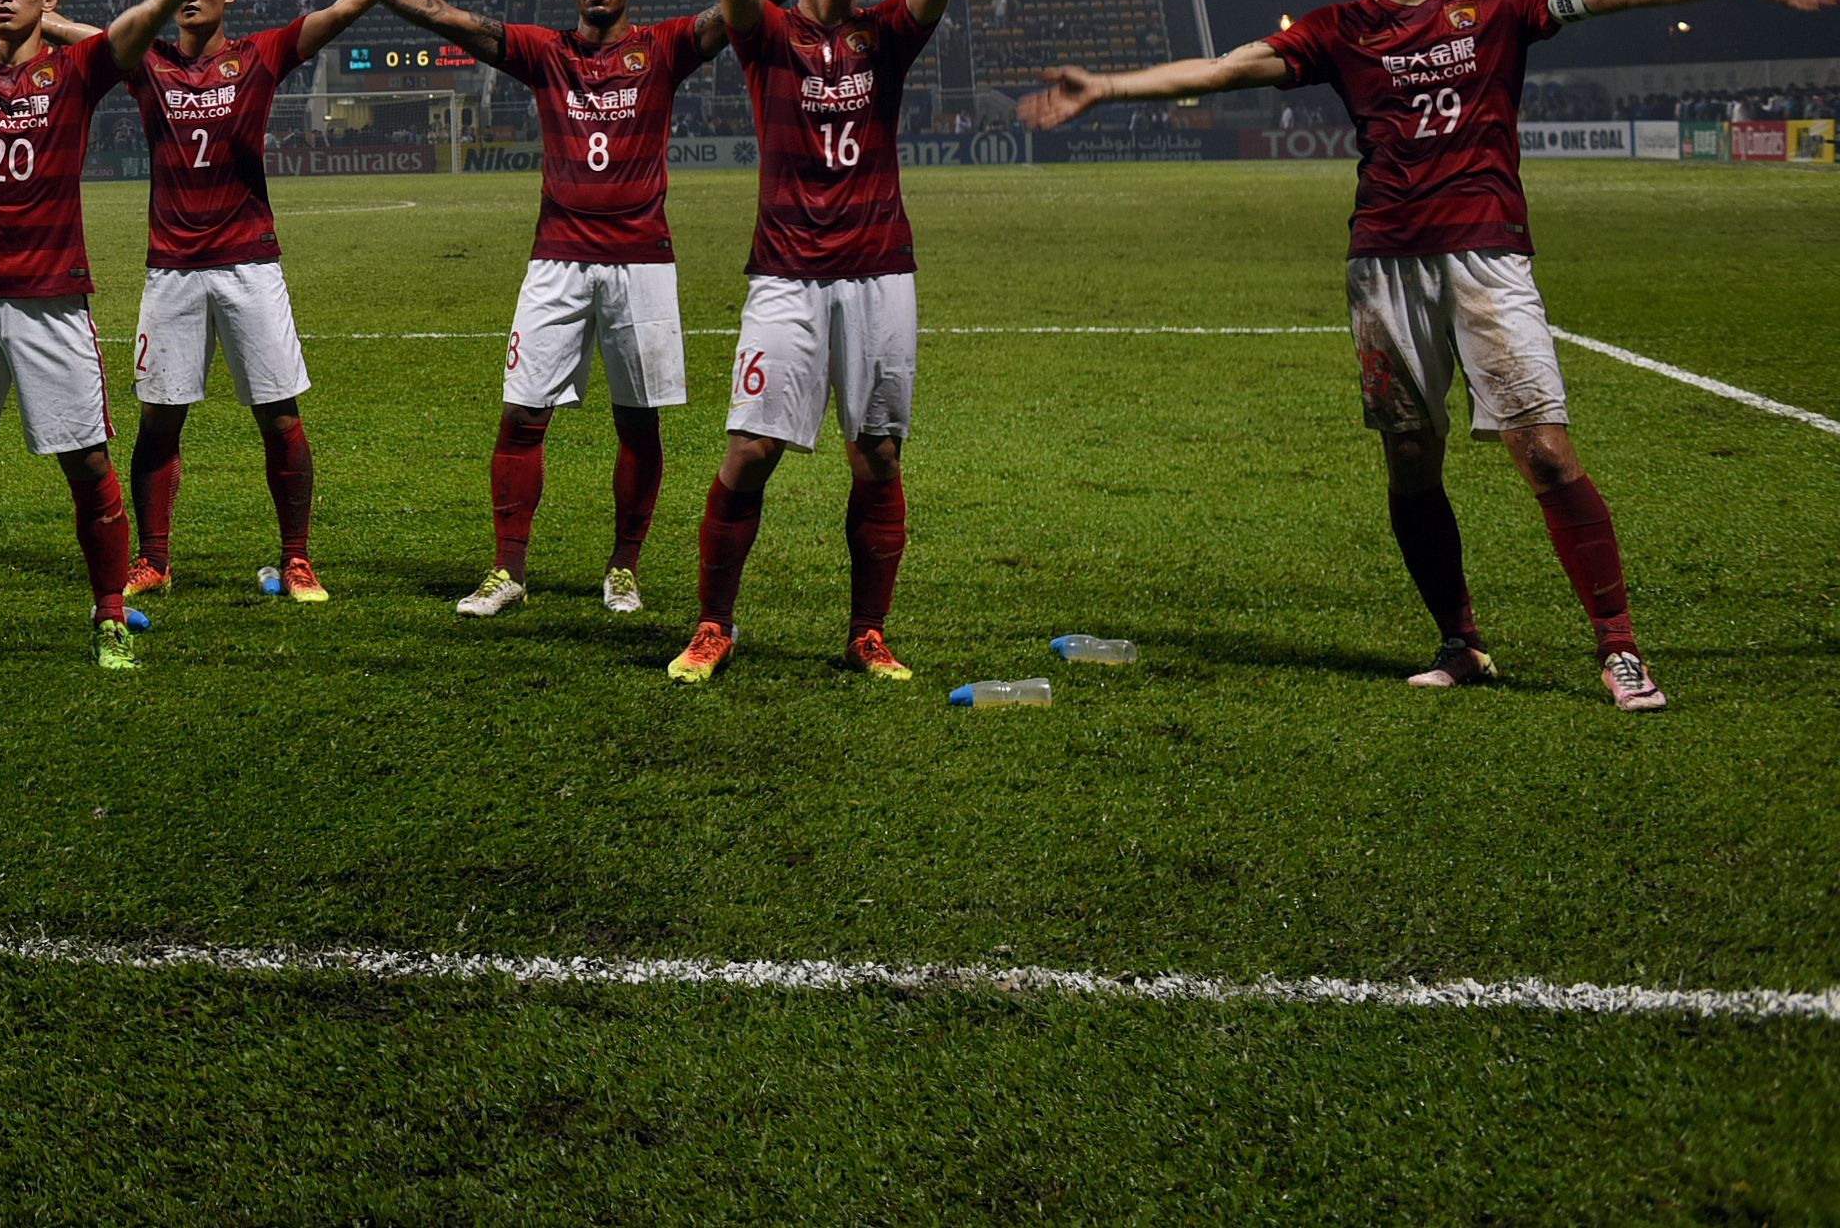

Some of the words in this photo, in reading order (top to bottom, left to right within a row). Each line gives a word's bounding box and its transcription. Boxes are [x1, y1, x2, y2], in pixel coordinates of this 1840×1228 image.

[1381, 36, 1477, 74] 恒大金服
[801, 69, 875, 100] 恒大金服
[1392, 61, 1477, 87] HDFAX.COM
[165, 85, 236, 108] 恒大金服
[566, 87, 638, 109] 恒大金服
[1412, 87, 1461, 139] 29
[567, 108, 636, 121] HDFAX.COM
[191, 128, 210, 168] 2
[587, 131, 609, 172] 8
[667, 145, 718, 163] QNB
[820, 121, 860, 168] 16
[1561, 130, 1586, 150] ONE
[1590, 130, 1624, 149] GOAL
[310, 149, 423, 173] Emirates
[136, 333, 148, 372] 2
[507, 331, 520, 371] 8
[734, 351, 765, 396] 16
